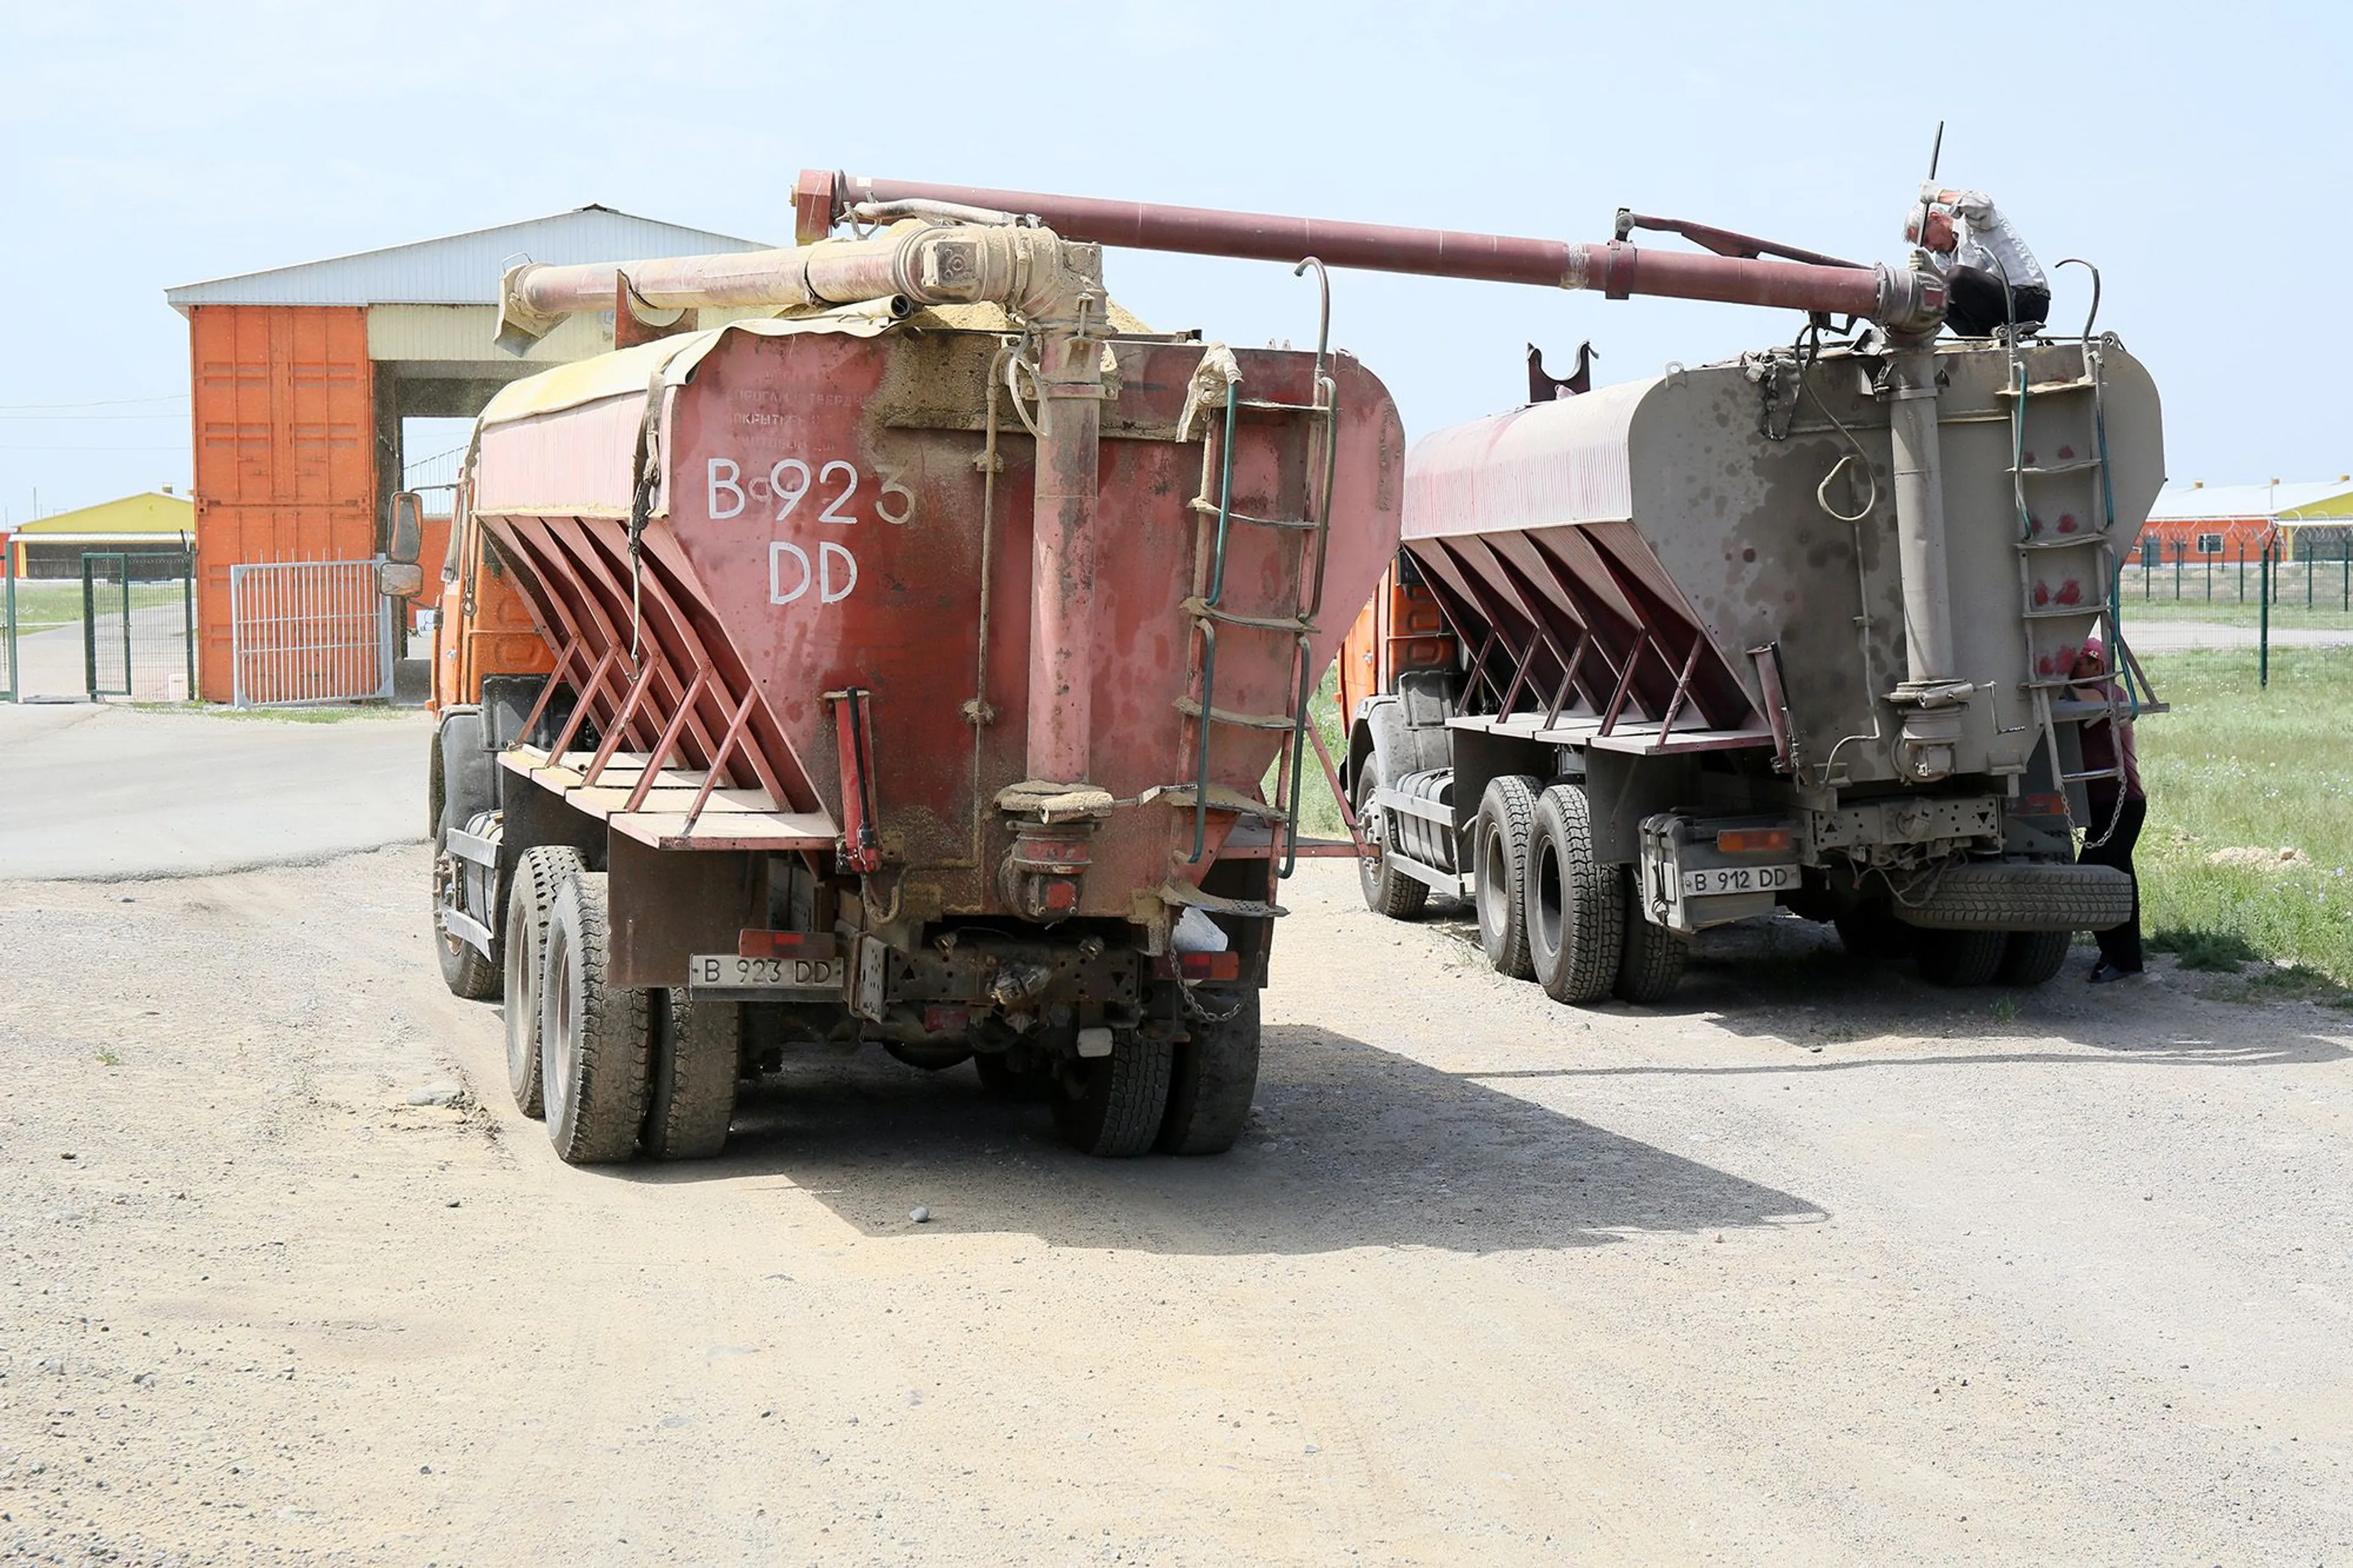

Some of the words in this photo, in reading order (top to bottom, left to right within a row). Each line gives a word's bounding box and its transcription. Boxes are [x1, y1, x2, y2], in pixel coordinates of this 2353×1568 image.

[770, 458, 915, 525] 923
[769, 541, 858, 604] DD
[1695, 874, 1707, 891] B
[1718, 870, 1750, 890] 912
[1759, 868, 1787, 887] DD
[705, 959, 720, 982] B
[736, 959, 782, 984] 923
[795, 960, 831, 983] DD
